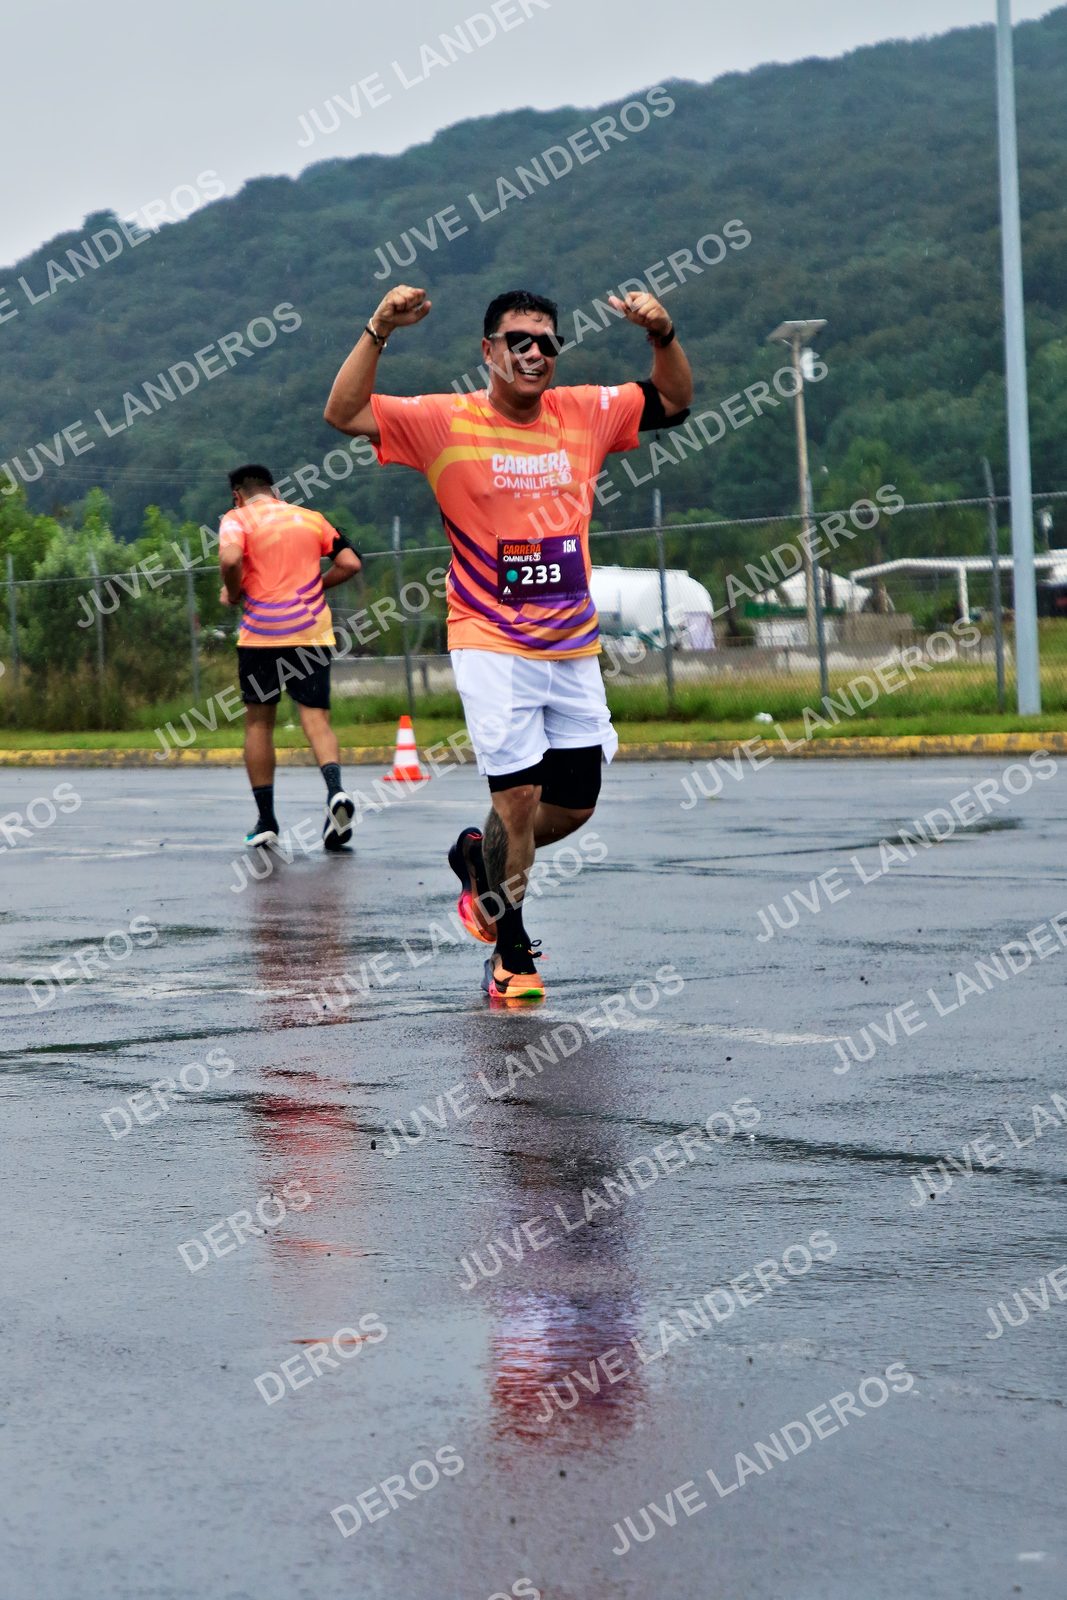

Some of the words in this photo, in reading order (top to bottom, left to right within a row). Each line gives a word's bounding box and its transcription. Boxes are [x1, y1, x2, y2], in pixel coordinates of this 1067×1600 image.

[492, 449, 570, 475] CARRERA
[494, 475, 557, 489] OMNILIFE
[503, 544, 541, 555] CARRERA
[521, 563, 561, 585] 233
